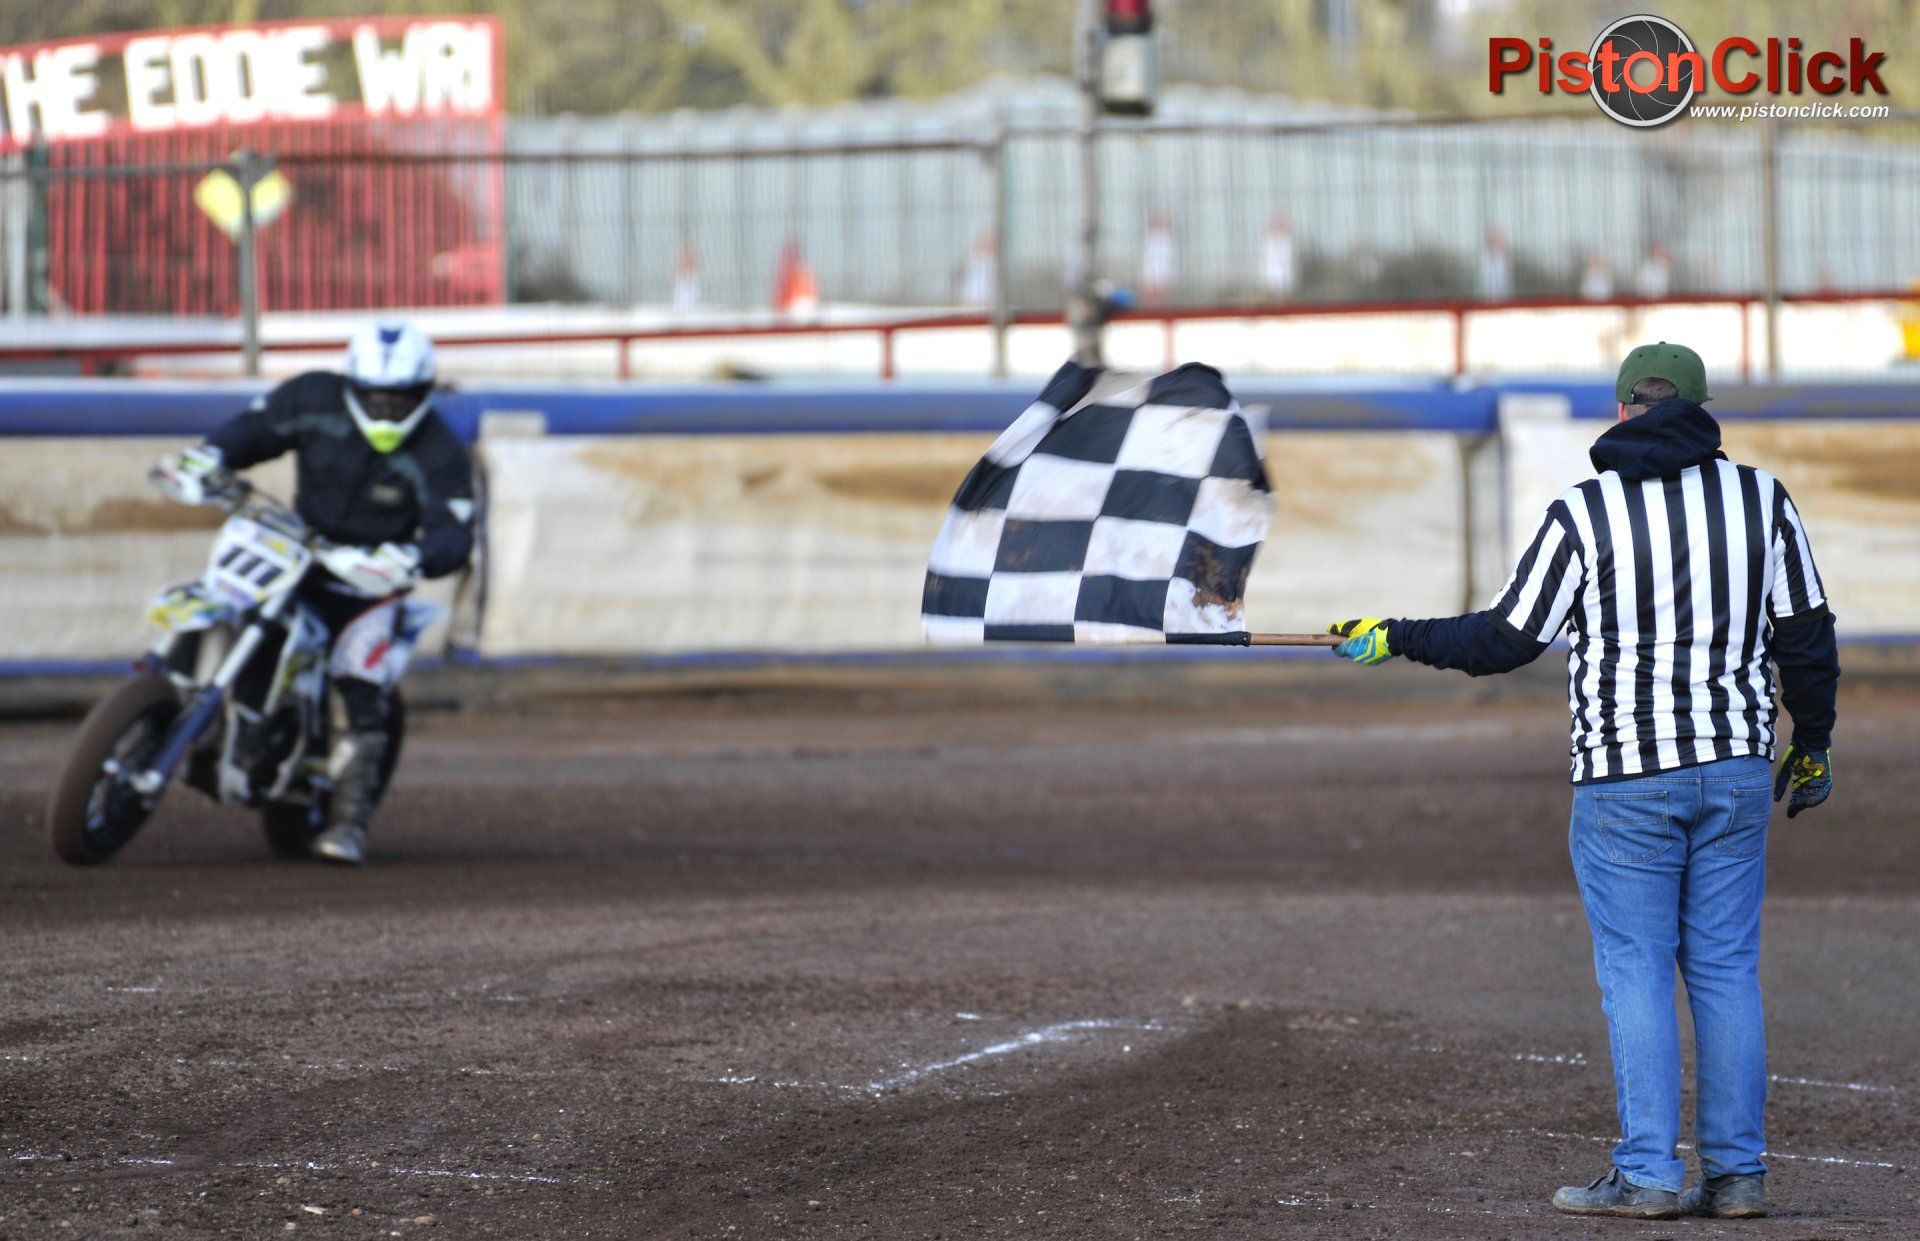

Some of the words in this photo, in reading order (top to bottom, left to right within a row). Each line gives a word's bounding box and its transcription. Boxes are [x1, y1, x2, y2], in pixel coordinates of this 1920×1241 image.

[0, 43, 108, 143] HE
[123, 26, 338, 131] EDDIE
[217, 545, 285, 588] 111
